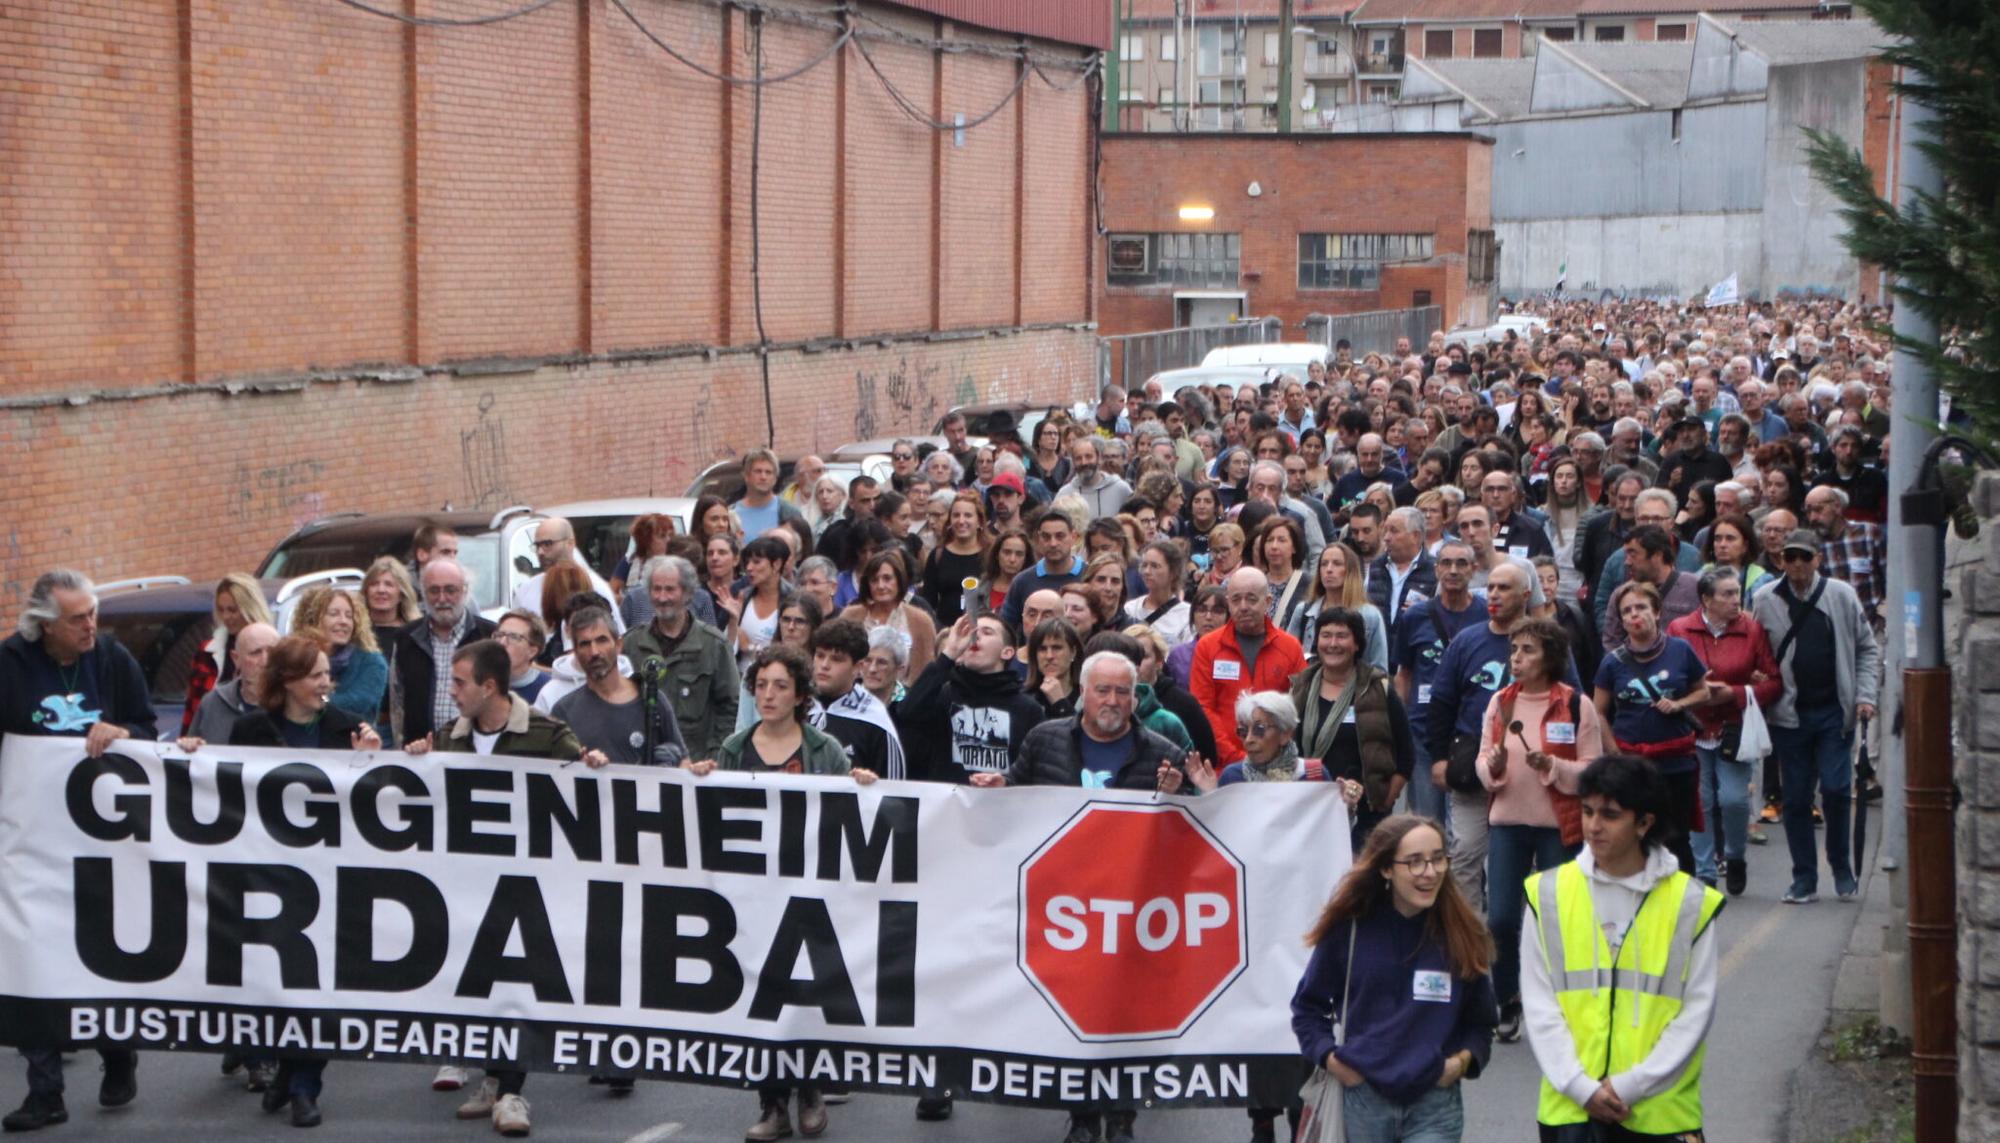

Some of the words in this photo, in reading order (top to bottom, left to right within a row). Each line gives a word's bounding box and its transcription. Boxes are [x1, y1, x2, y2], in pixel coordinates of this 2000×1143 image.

[958, 745, 1008, 770] ORTATU
[65, 752, 920, 883] GUGGENHEIM
[74, 856, 919, 1027] URDAIBAI
[1043, 892, 1231, 955] STOP
[71, 1007, 519, 1061] BUSTURIALDEAREN
[553, 1030, 937, 1089] ETORKIZUNAREN
[971, 1058, 1249, 1101] DEFENTSAN
